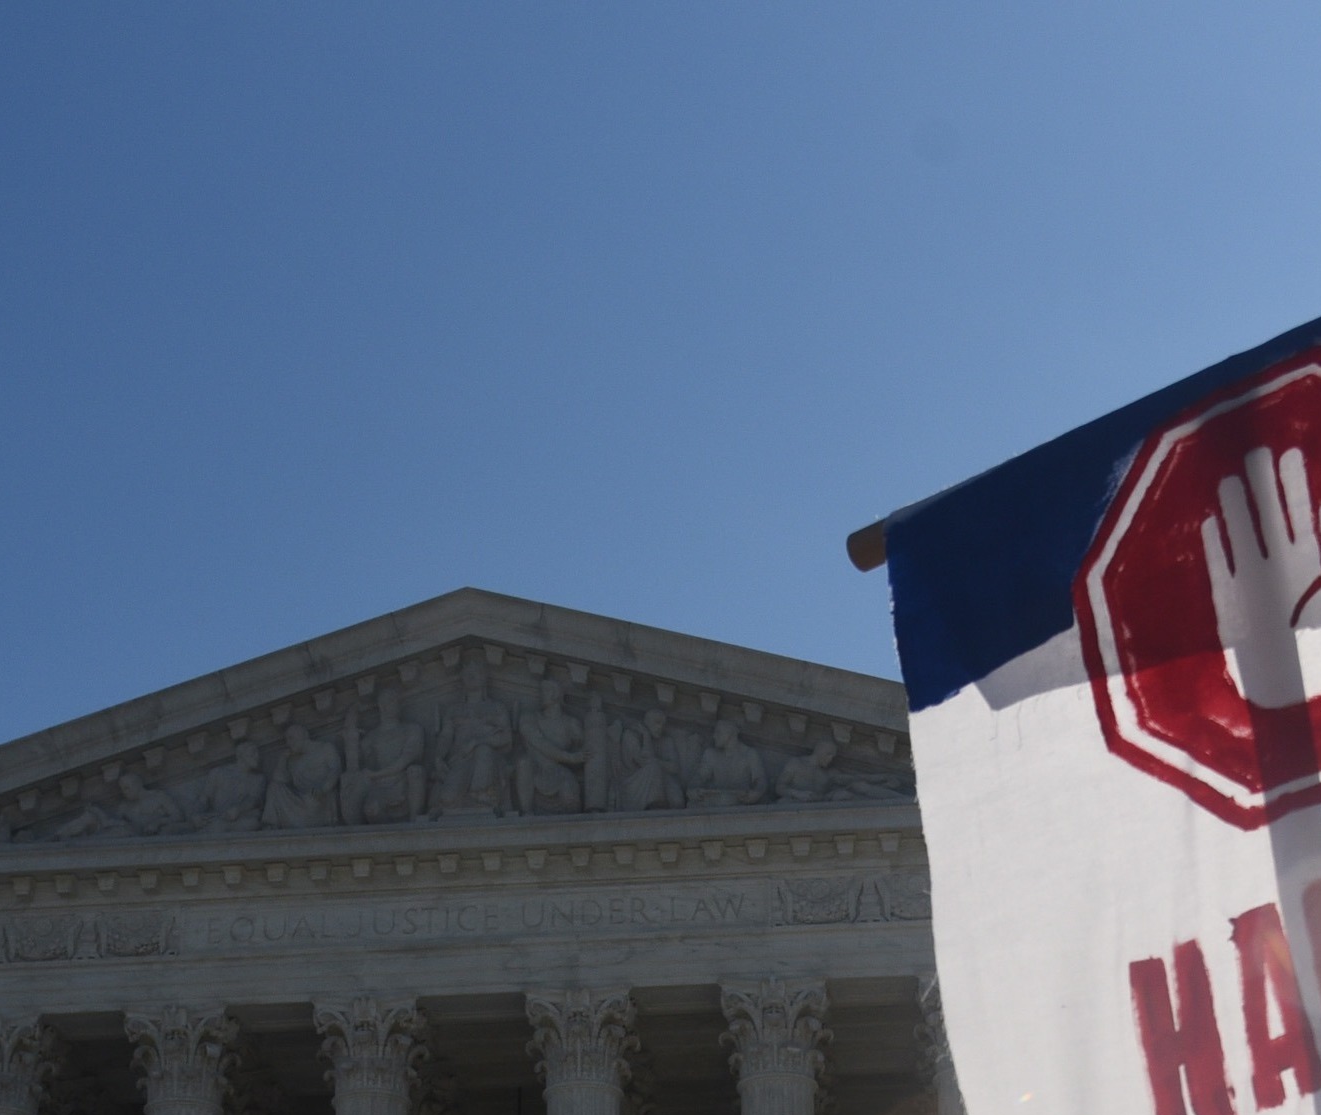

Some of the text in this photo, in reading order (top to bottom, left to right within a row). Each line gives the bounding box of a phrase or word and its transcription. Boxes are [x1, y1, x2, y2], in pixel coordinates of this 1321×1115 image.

[207, 892, 746, 945] EQUAL JUSTICE UNDER LAW
